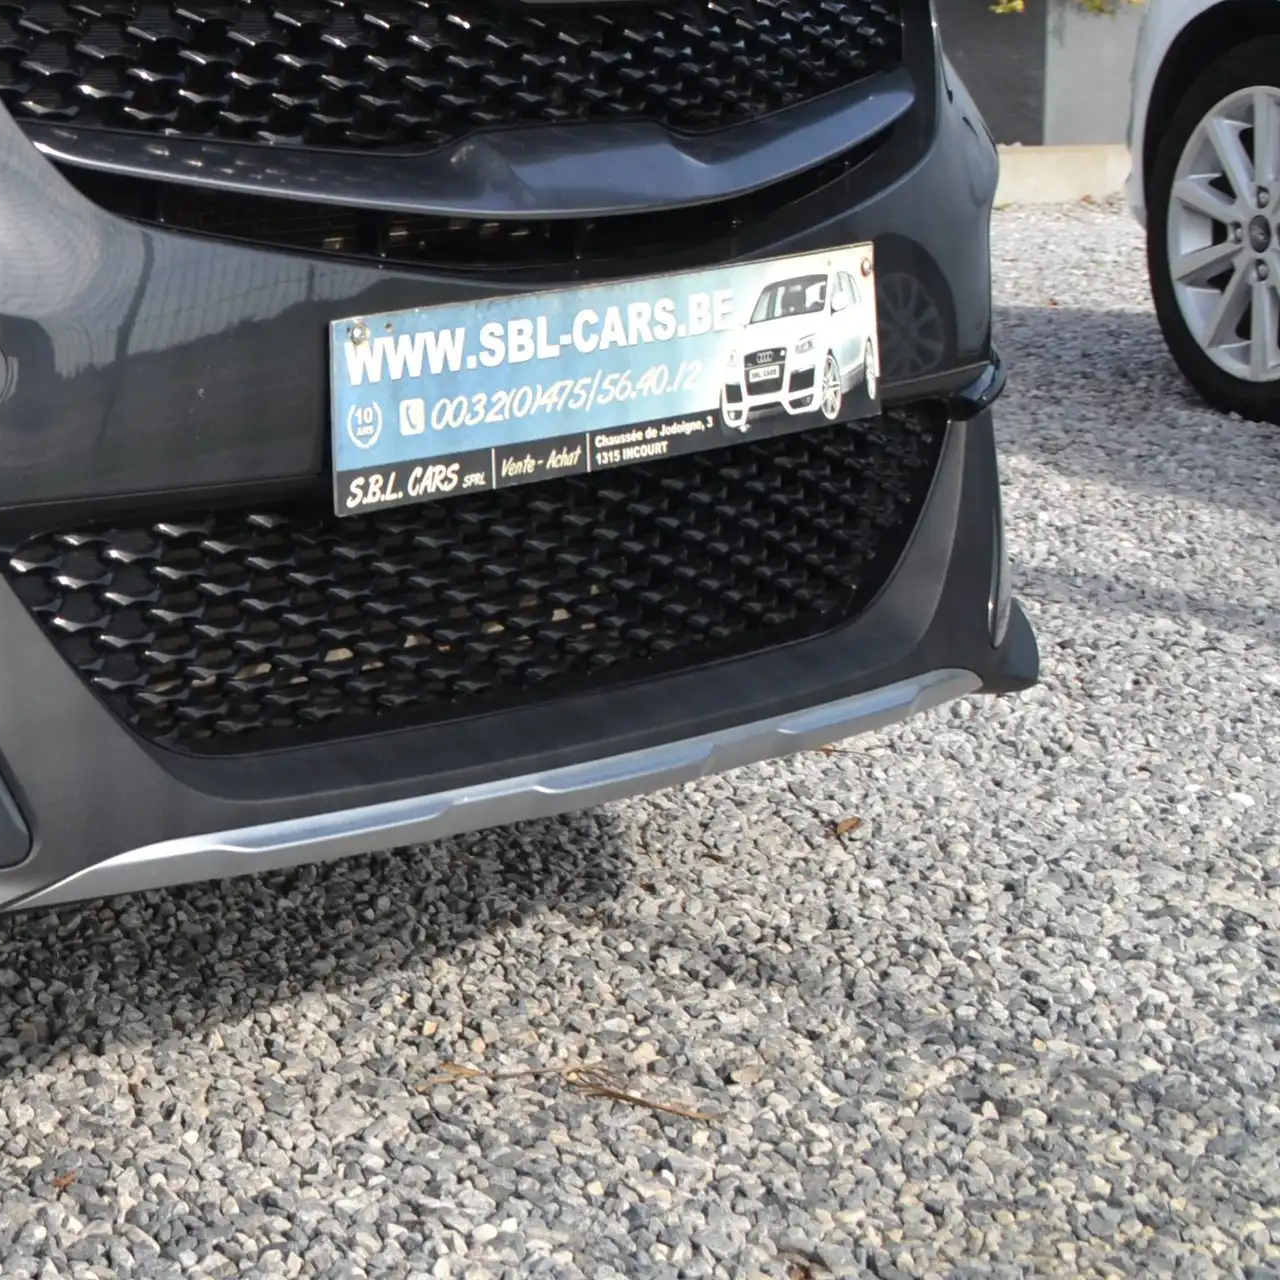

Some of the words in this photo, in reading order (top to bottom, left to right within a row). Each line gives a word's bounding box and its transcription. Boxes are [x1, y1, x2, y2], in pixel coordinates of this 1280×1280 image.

[343, 288, 735, 387] WWW.SBL-CARS.BE
[354, 407, 374, 425] 10
[594, 428, 643, 448] Chaussée
[645, 428, 658, 439] de
[659, 419, 705, 438] Jodoigne,
[706, 416, 713, 427] 3
[501, 454, 535, 478] Vente
[546, 445, 582, 470] Achat
[595, 451, 621, 466] 1315
[623, 440, 669, 460] INCOURT
[346, 472, 403, 508] S.B.L.
[407, 462, 461, 497] CARS
